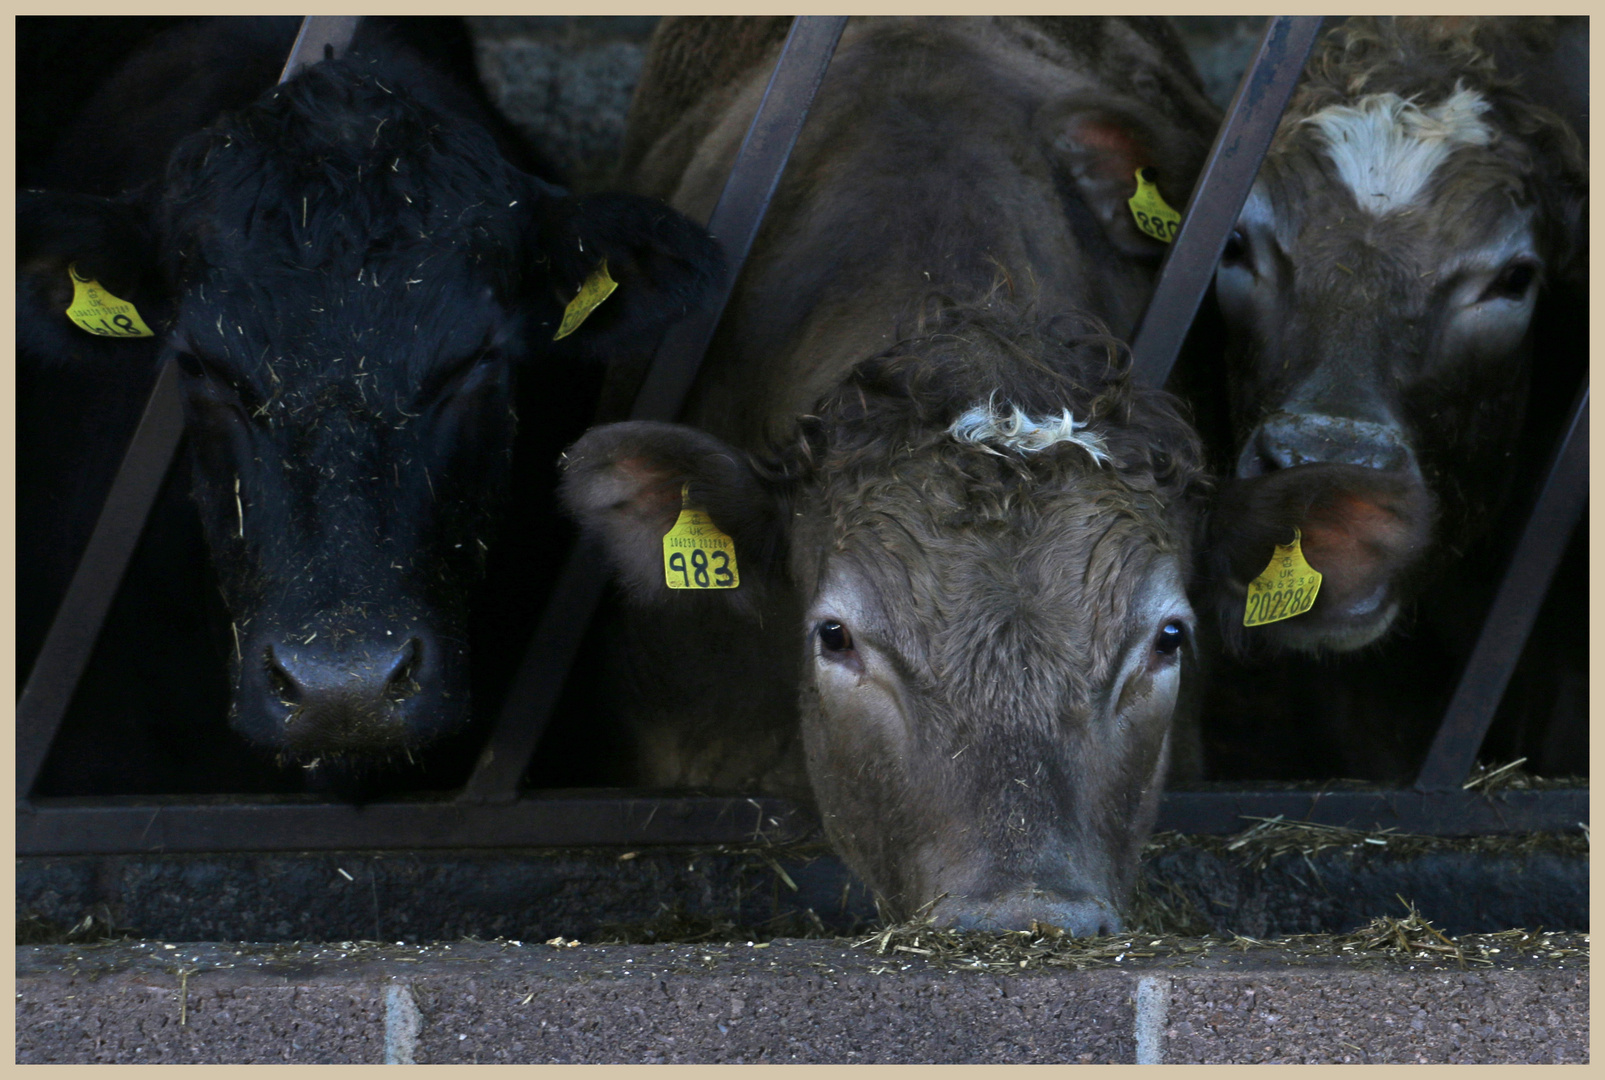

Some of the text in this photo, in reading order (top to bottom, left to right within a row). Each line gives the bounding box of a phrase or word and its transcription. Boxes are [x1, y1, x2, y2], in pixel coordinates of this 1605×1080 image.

[689, 527, 704, 536] UK
[670, 537, 696, 548] 106230
[669, 548, 734, 587] 983
[1279, 568, 1295, 578] UK
[1246, 585, 1315, 624] 202286
